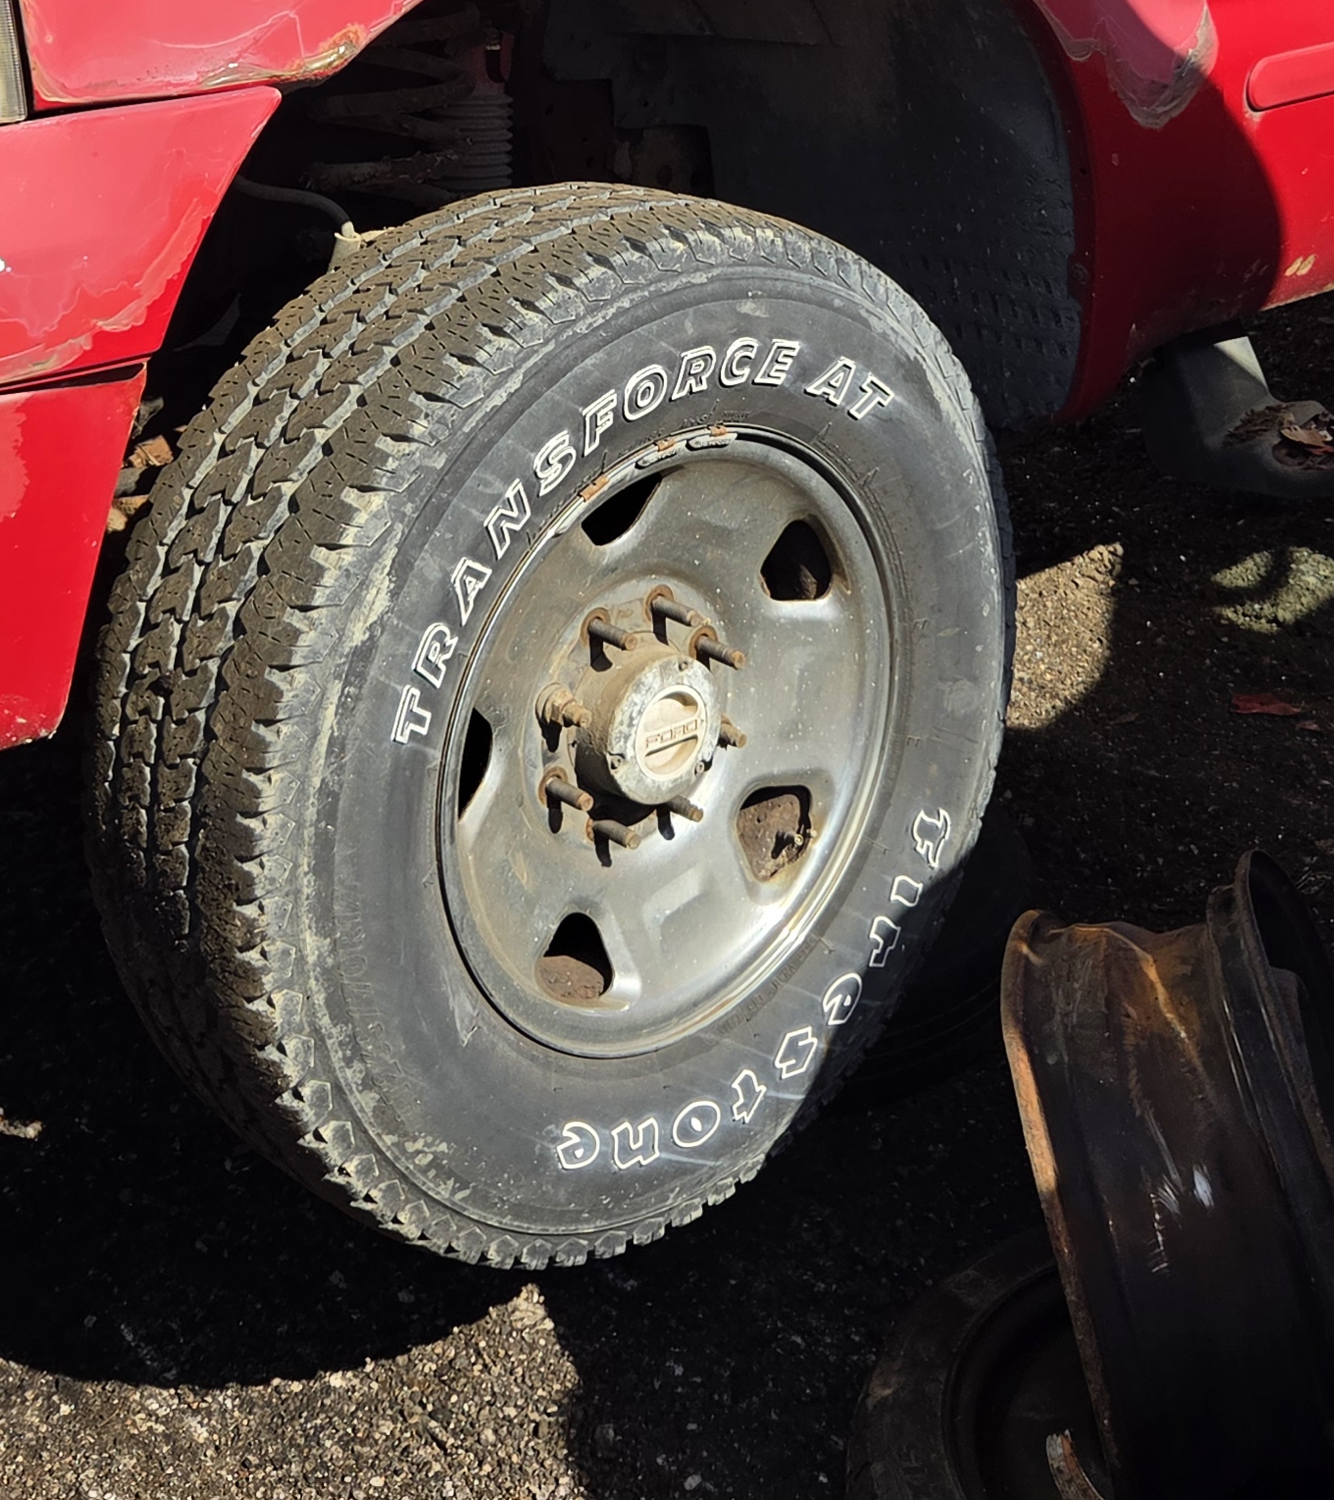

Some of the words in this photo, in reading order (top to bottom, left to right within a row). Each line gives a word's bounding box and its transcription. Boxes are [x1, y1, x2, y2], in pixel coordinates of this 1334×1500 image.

[392, 337, 801, 745] TRANSFORCE
[805, 355, 895, 421] AT
[646, 718, 698, 749] FORD
[557, 807, 951, 1171] Firestone
